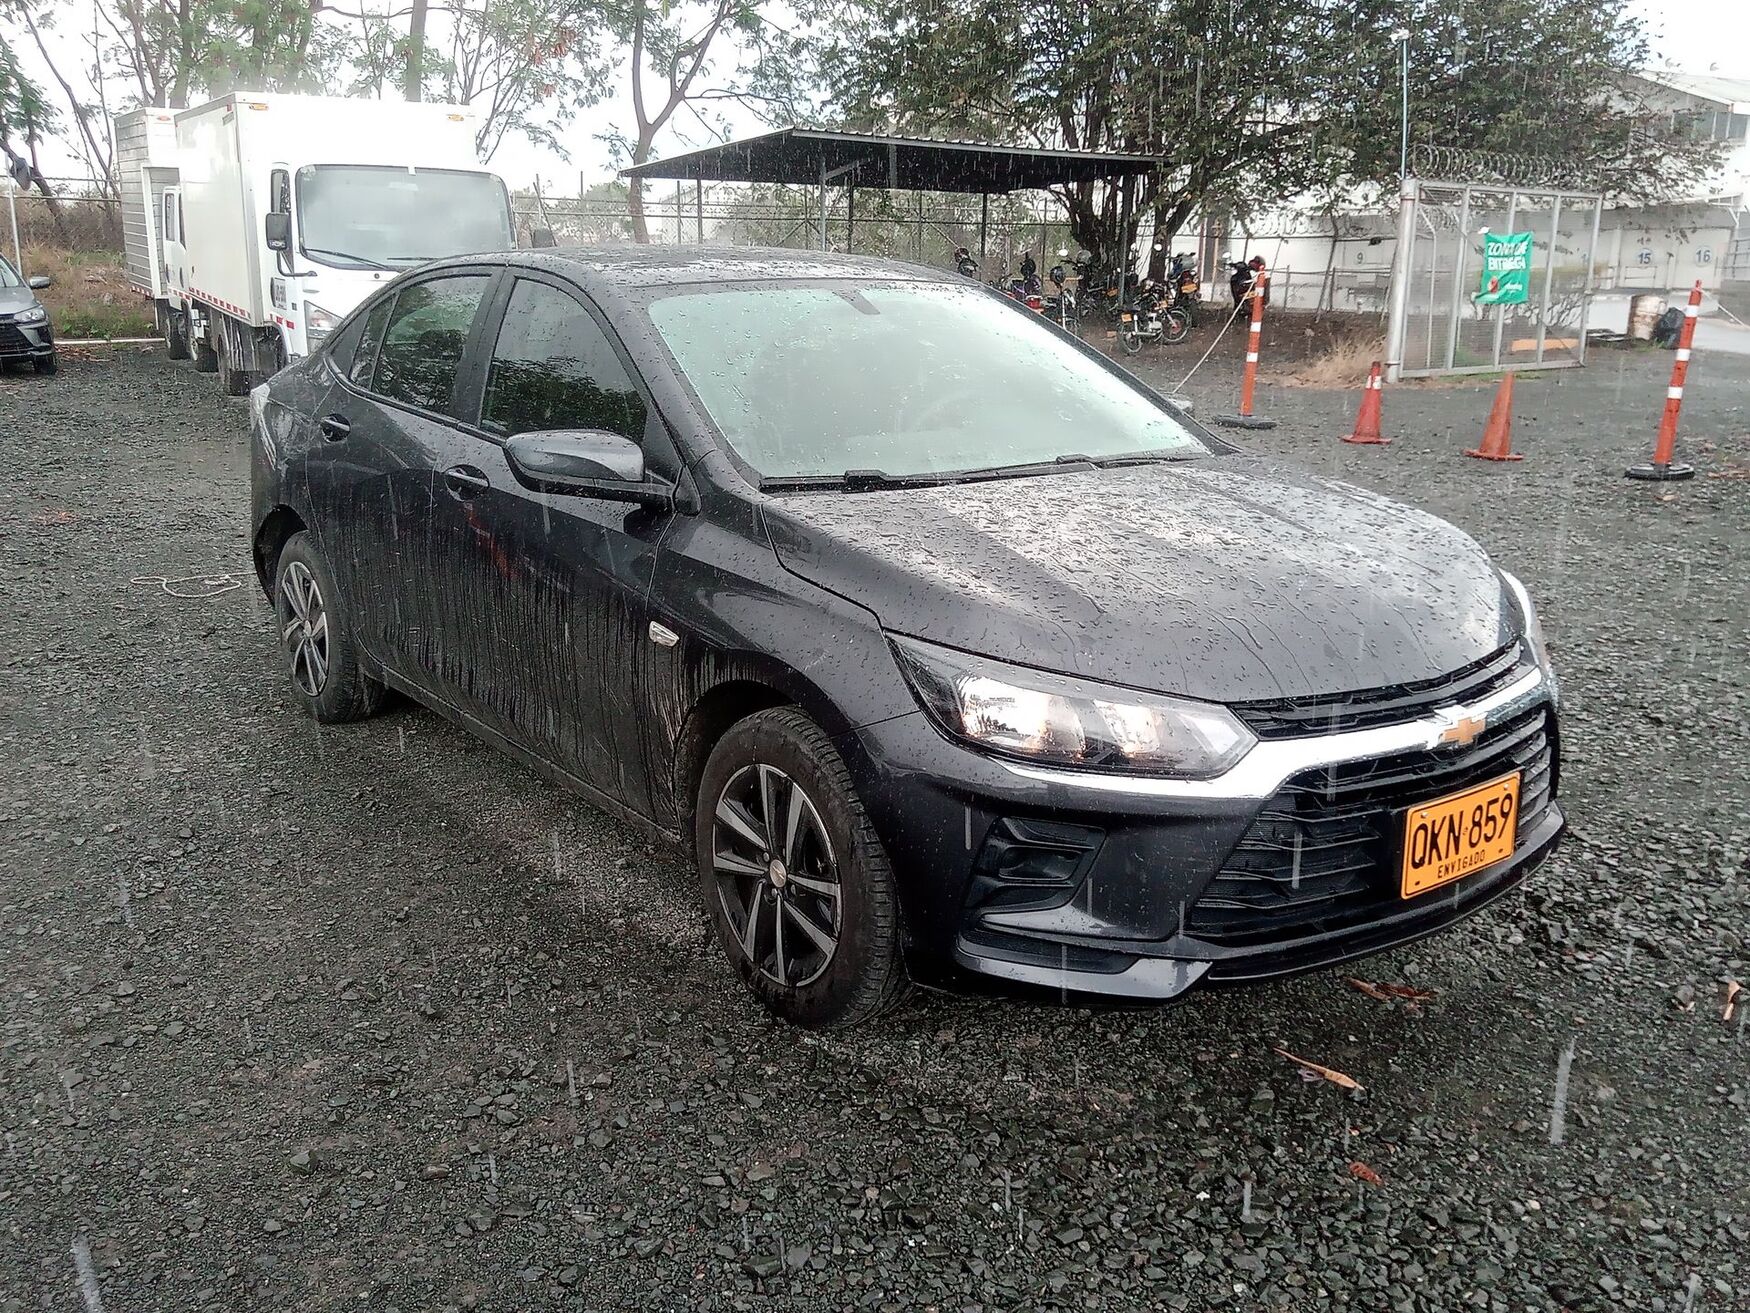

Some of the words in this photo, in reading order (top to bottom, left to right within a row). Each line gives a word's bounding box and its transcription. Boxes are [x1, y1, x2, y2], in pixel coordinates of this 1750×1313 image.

[1357, 252, 1363, 264] 9
[1638, 252, 1651, 264] 15
[1696, 250, 1711, 262] 16
[1437, 850, 1486, 879] ENVIGADO
